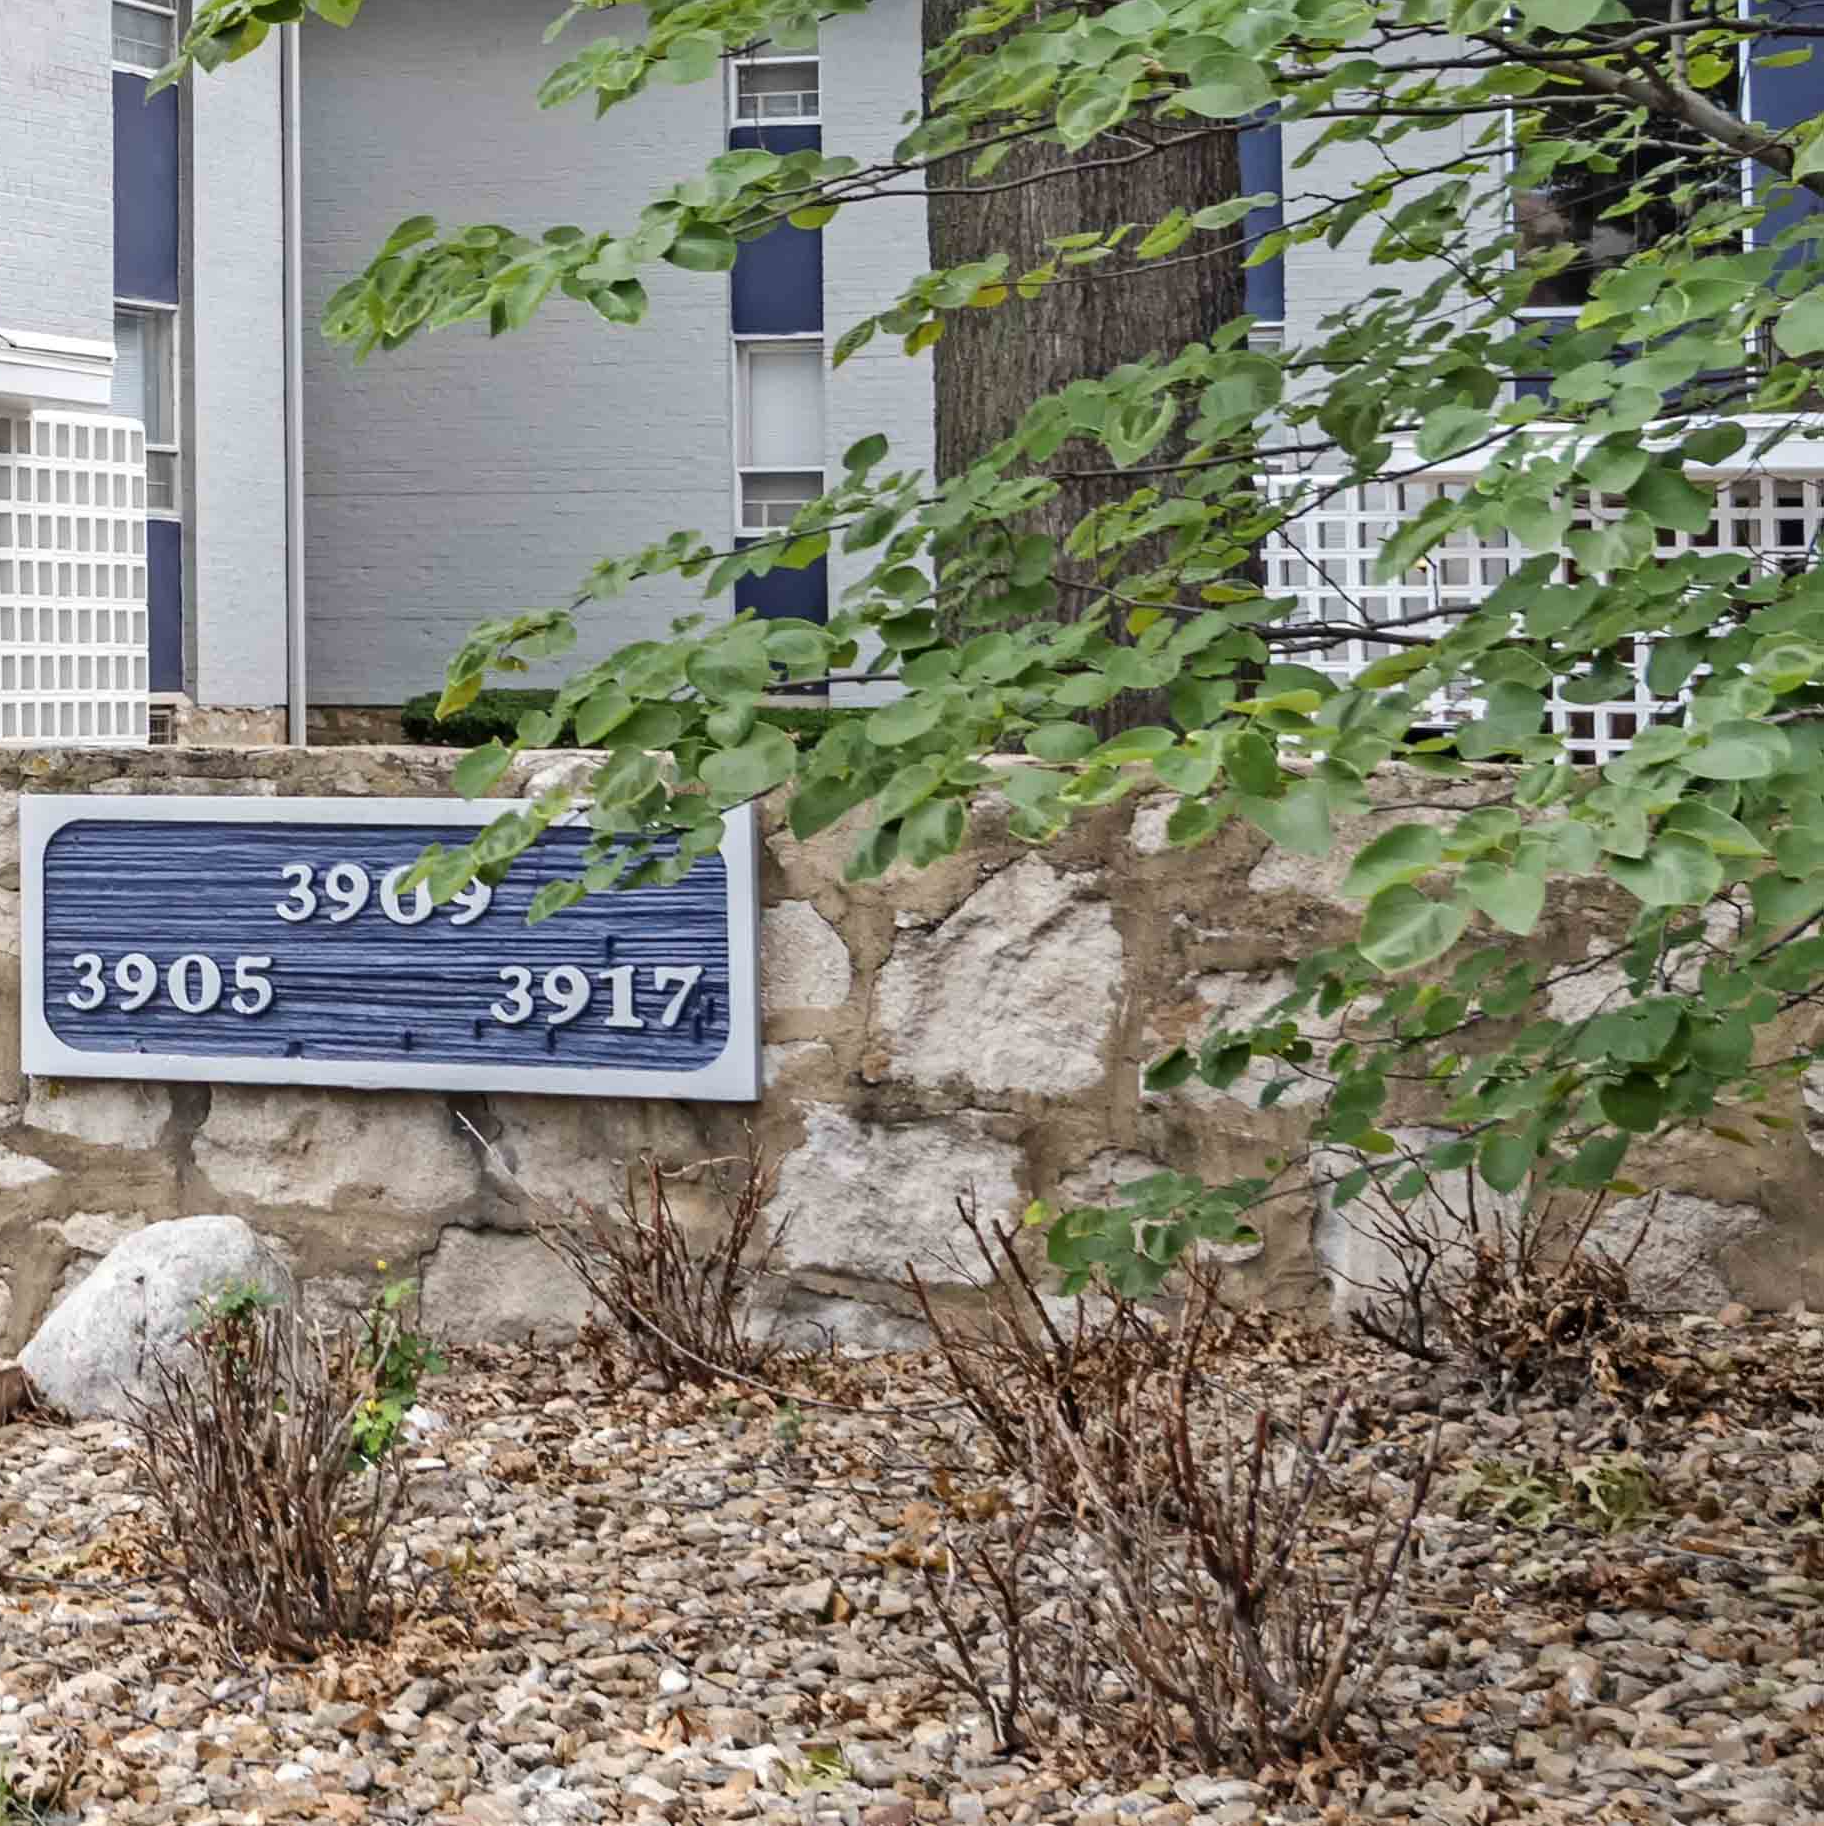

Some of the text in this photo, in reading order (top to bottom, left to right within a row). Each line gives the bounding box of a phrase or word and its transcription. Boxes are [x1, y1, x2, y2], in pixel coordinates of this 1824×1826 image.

[275, 863, 493, 925] 3909
[67, 953, 274, 1014] 3905
[489, 964, 704, 1028] 3917
